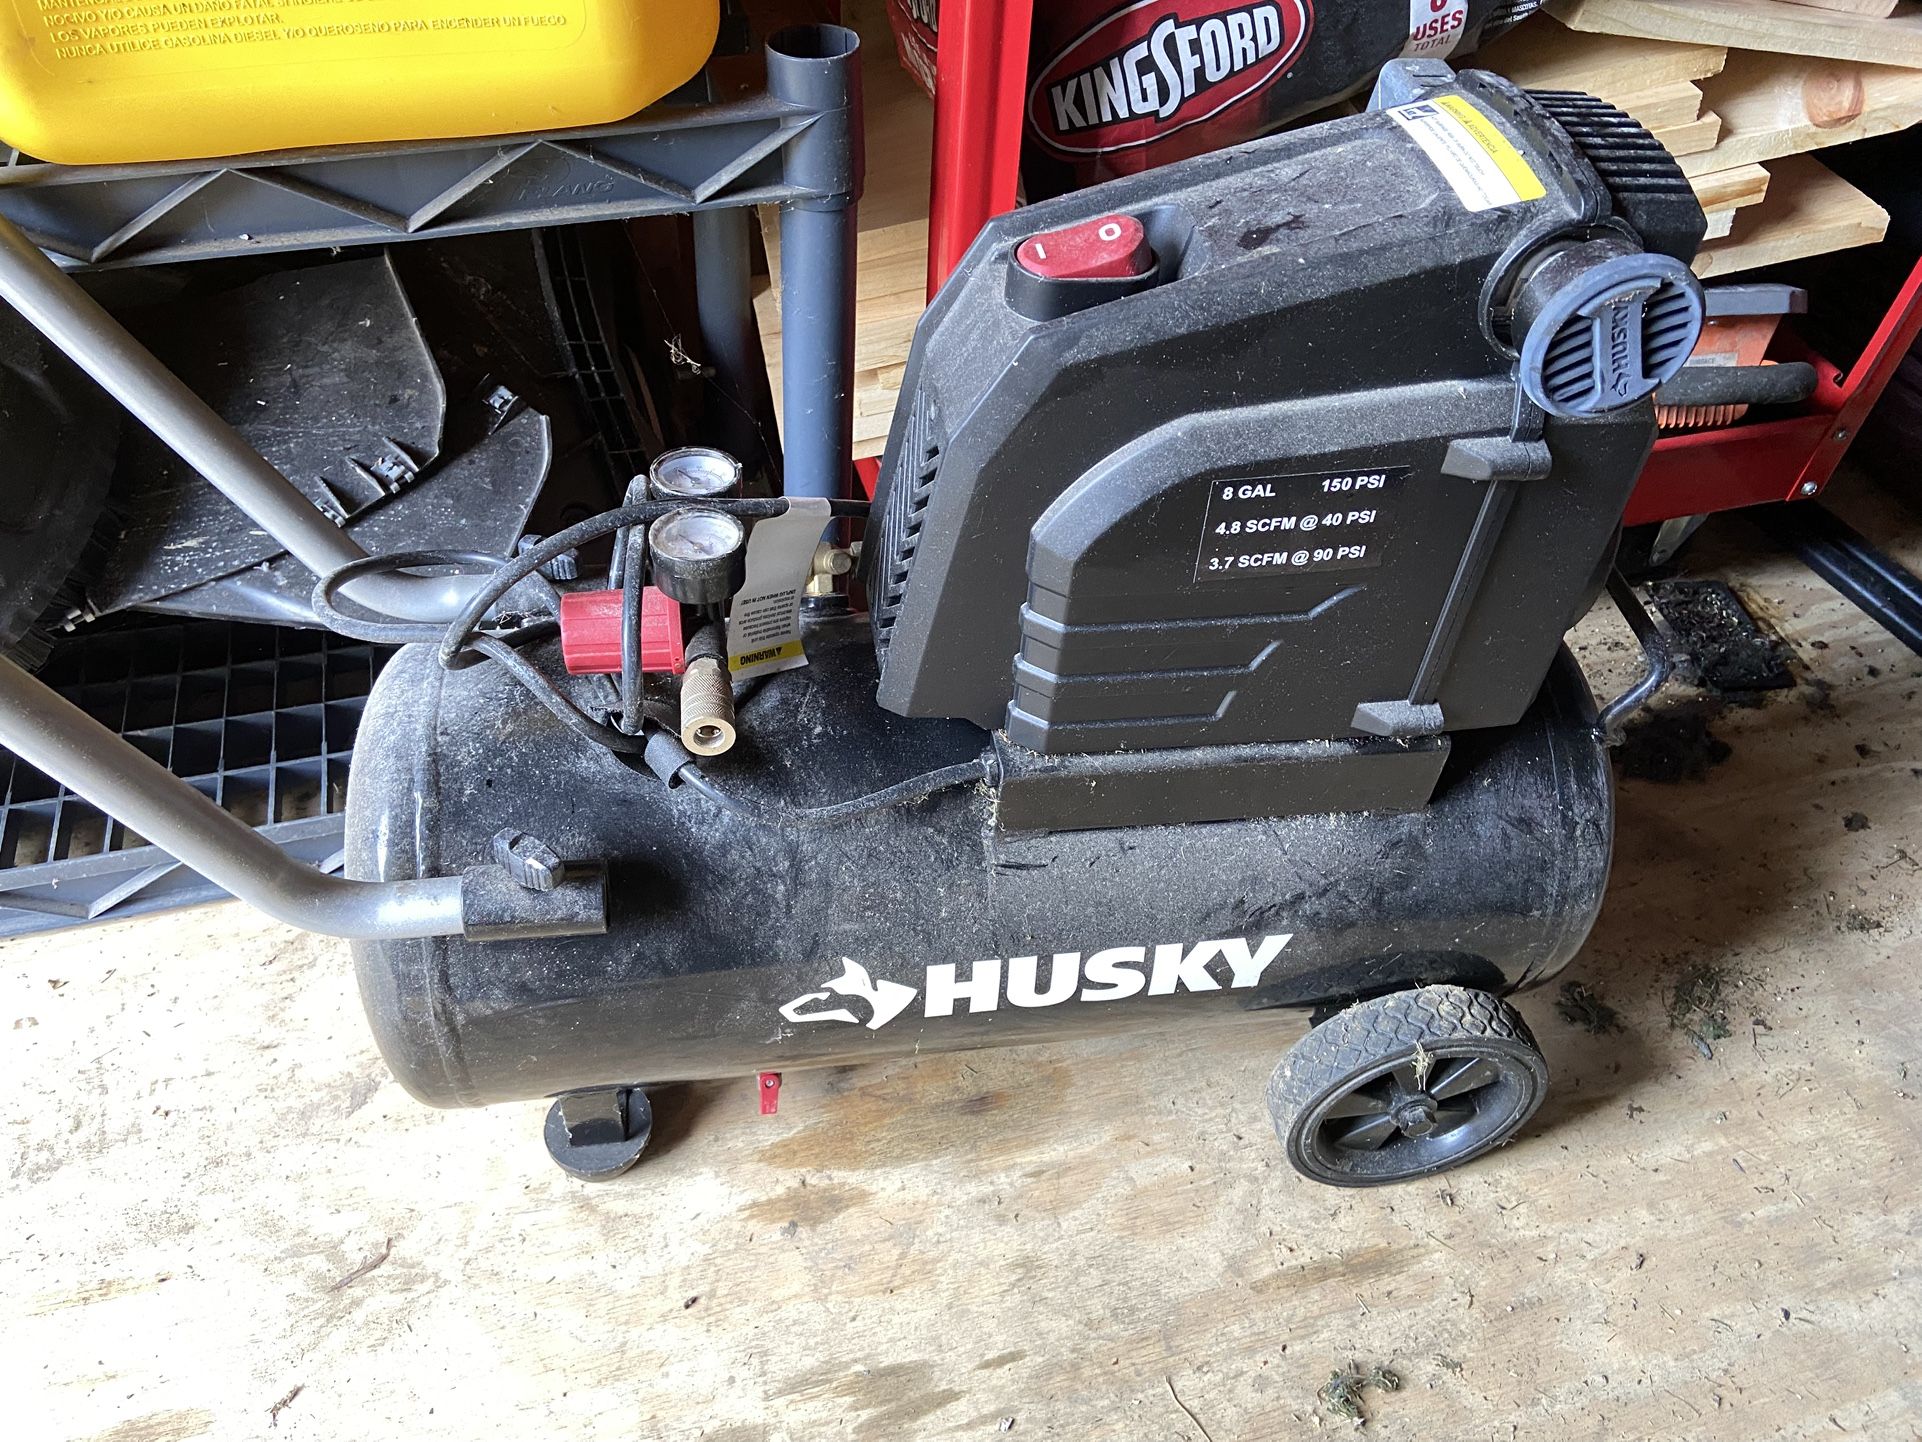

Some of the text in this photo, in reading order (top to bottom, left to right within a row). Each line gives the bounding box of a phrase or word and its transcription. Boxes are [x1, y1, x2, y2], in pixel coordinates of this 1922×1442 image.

[43, 11, 97, 27] NOCIVO
[98, 8, 122, 21] Y/O
[125, 3, 172, 18] CAUSA
[1412, 9, 1464, 41] USES
[50, 29, 80, 43] LOS
[79, 22, 149, 40] VAPORES
[151, 18, 209, 33] PUEDEN
[55, 43, 107, 59] NUNCA
[108, 38, 162, 54] UTILICE
[164, 33, 233, 49] GASOLINA
[233, 29, 281, 43] DIESEL
[308, 21, 391, 38] QUEROSENO
[393, 19, 430, 32] PARA
[431, 16, 501, 30] ENCENDER
[503, 15, 522, 27] UN
[523, 15, 567, 27] FUEGO
[1414, 34, 1451, 52] TOTAL
[1051, 5, 1281, 131] KINGSFORD
[1611, 305, 1629, 375] HUSKY
[1222, 474, 1387, 501] 8 GAL 150 PSI
[1215, 509, 1377, 535] 4.8 SCFM @ 40 PSI
[1209, 545, 1367, 570] 3.7 SCFM @ 90 PSI
[740, 648, 777, 665] WARNING
[924, 933, 1294, 1019] HUSKY
